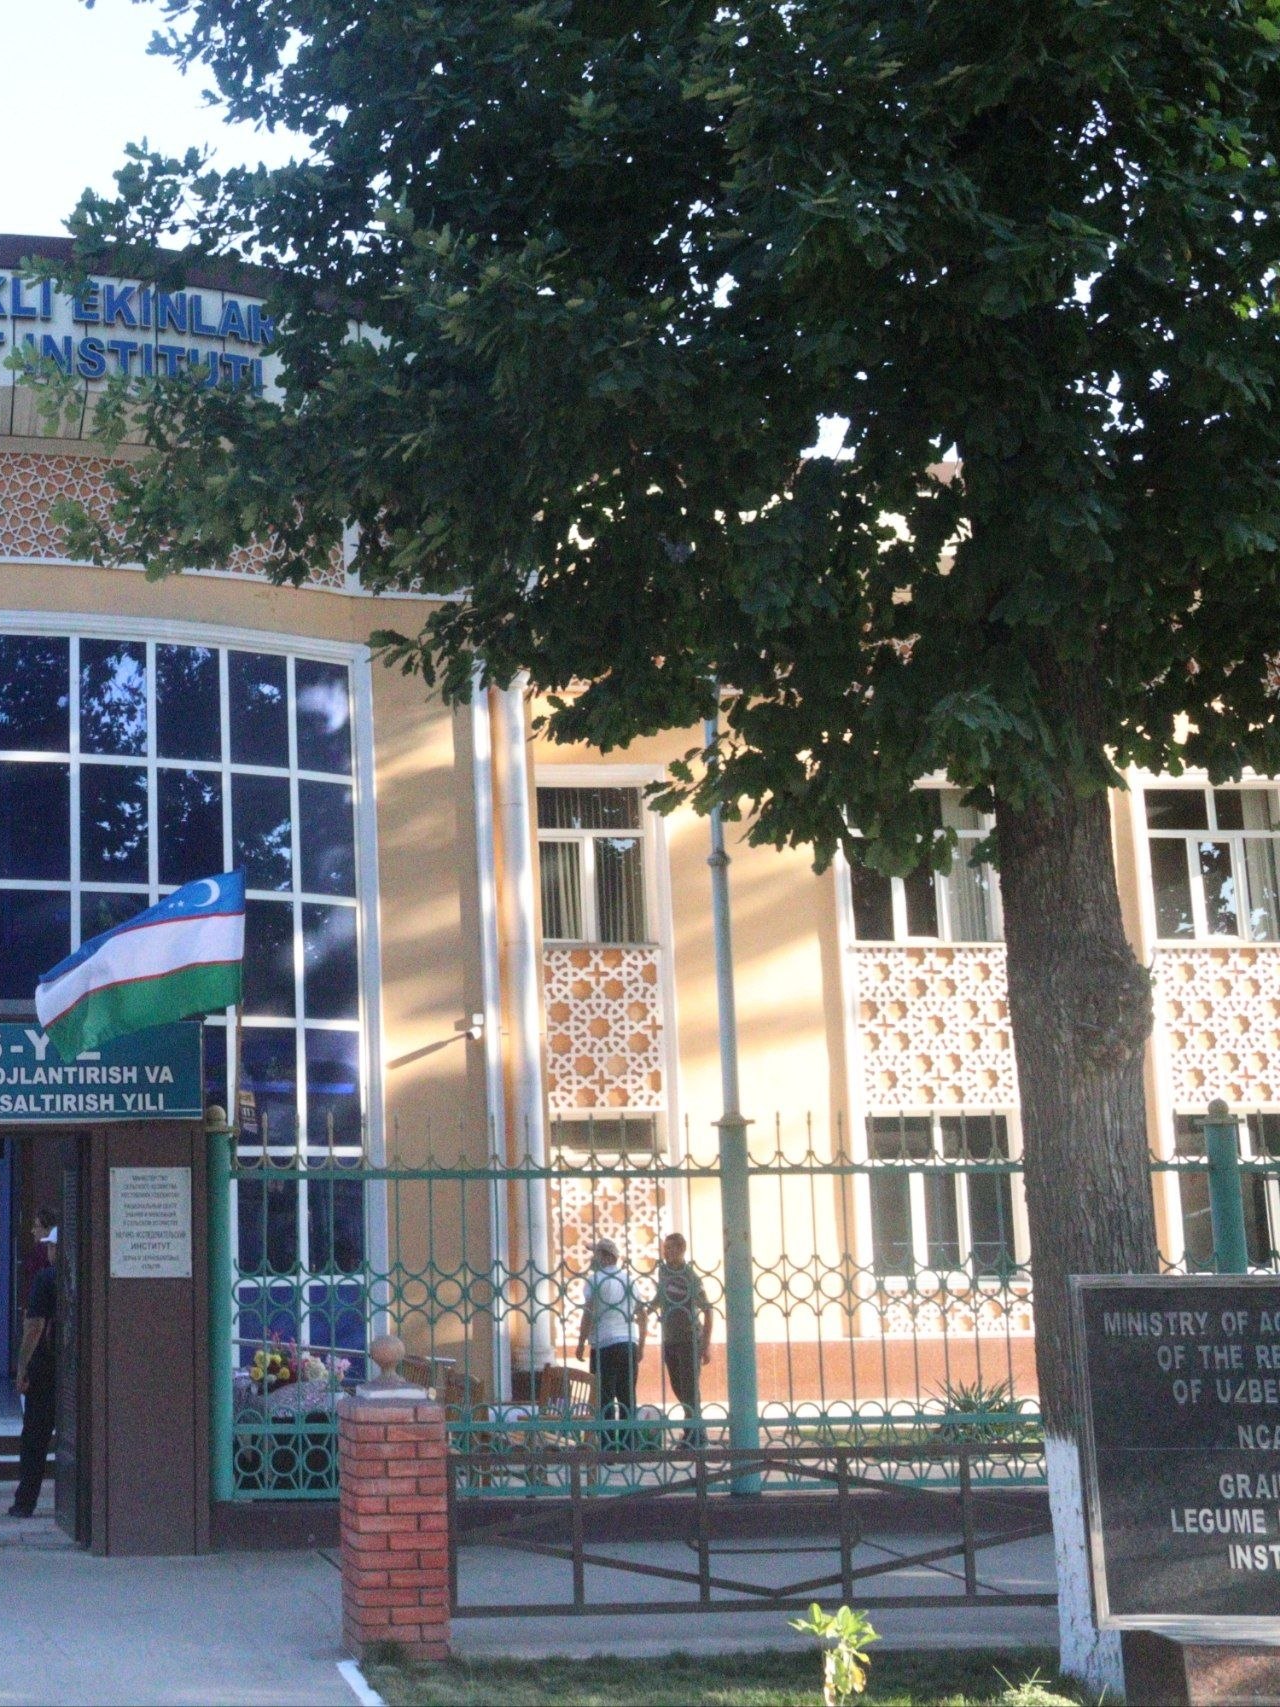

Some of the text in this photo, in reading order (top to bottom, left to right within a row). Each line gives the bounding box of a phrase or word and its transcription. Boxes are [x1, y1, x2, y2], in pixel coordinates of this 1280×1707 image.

[144, 1065, 174, 1084] VA
[121, 1093, 165, 1112] YILI
[130, 1242, 171, 1250] ИНСТИТУТ
[1103, 1311, 1208, 1336] MINISTRY
[1221, 1311, 1248, 1336] OF
[1157, 1345, 1186, 1371] OF
[1198, 1344, 1244, 1369] THE
[1172, 1378, 1280, 1403] OF UZBE
[1219, 1473, 1280, 1499] GRAI
[1170, 1508, 1267, 1534] LEGUME
[1228, 1544, 1280, 1570] INST
